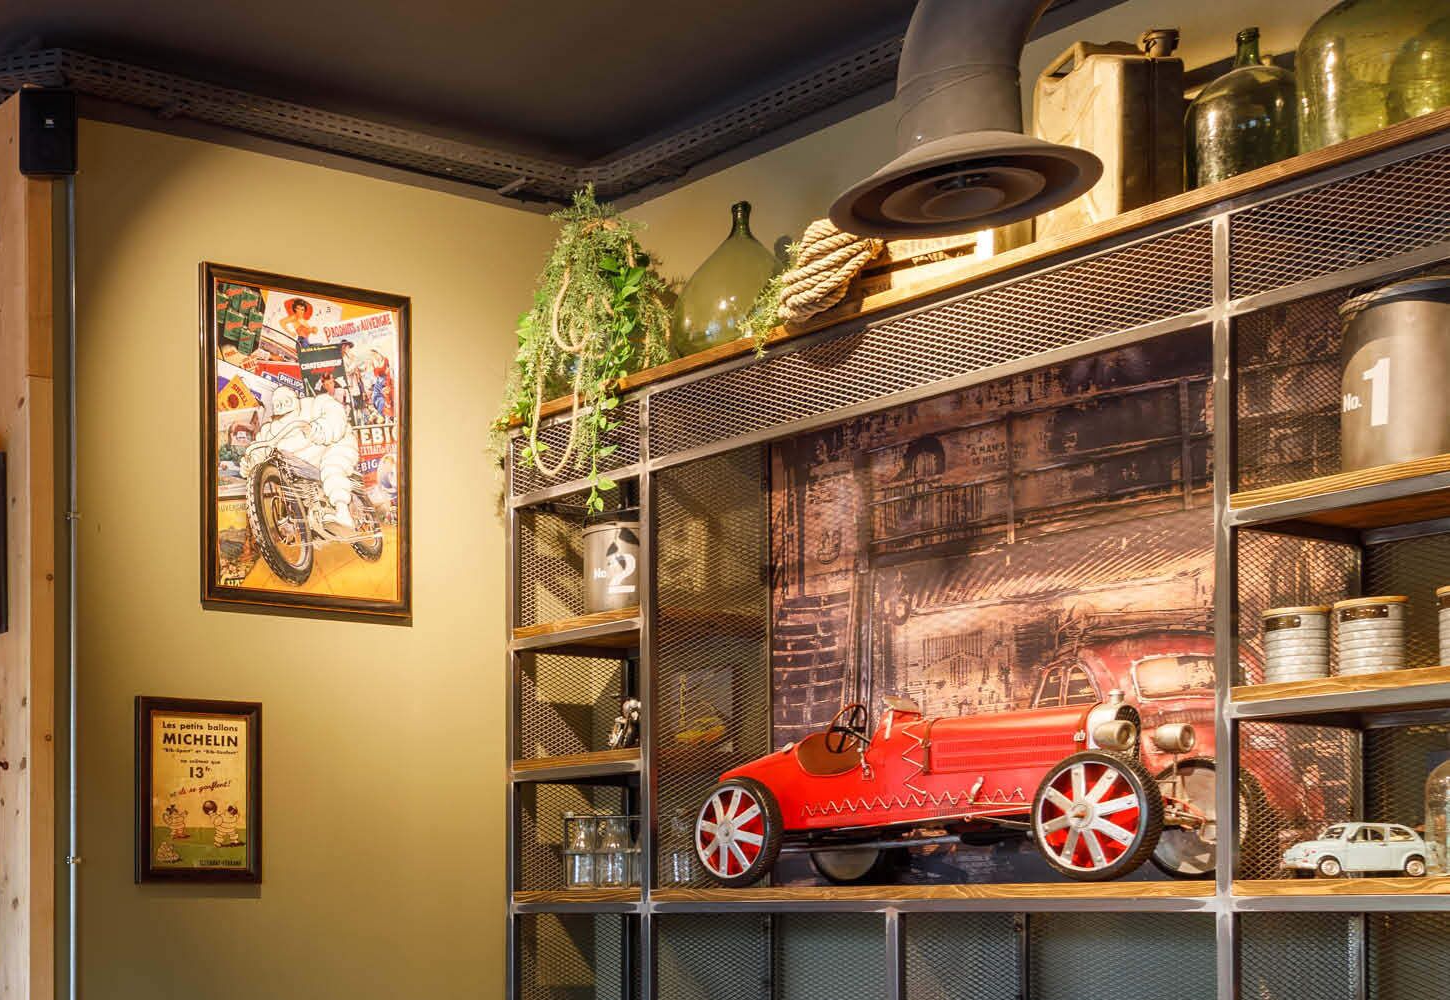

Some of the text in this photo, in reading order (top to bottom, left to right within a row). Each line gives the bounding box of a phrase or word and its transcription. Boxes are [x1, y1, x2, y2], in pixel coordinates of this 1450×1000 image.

[231, 383, 248, 406] SHELL
[1361, 357, 1391, 427] 1
[606, 552, 637, 593] 2
[162, 721, 238, 732] Les petits ballons
[162, 732, 238, 747] MICHELIN
